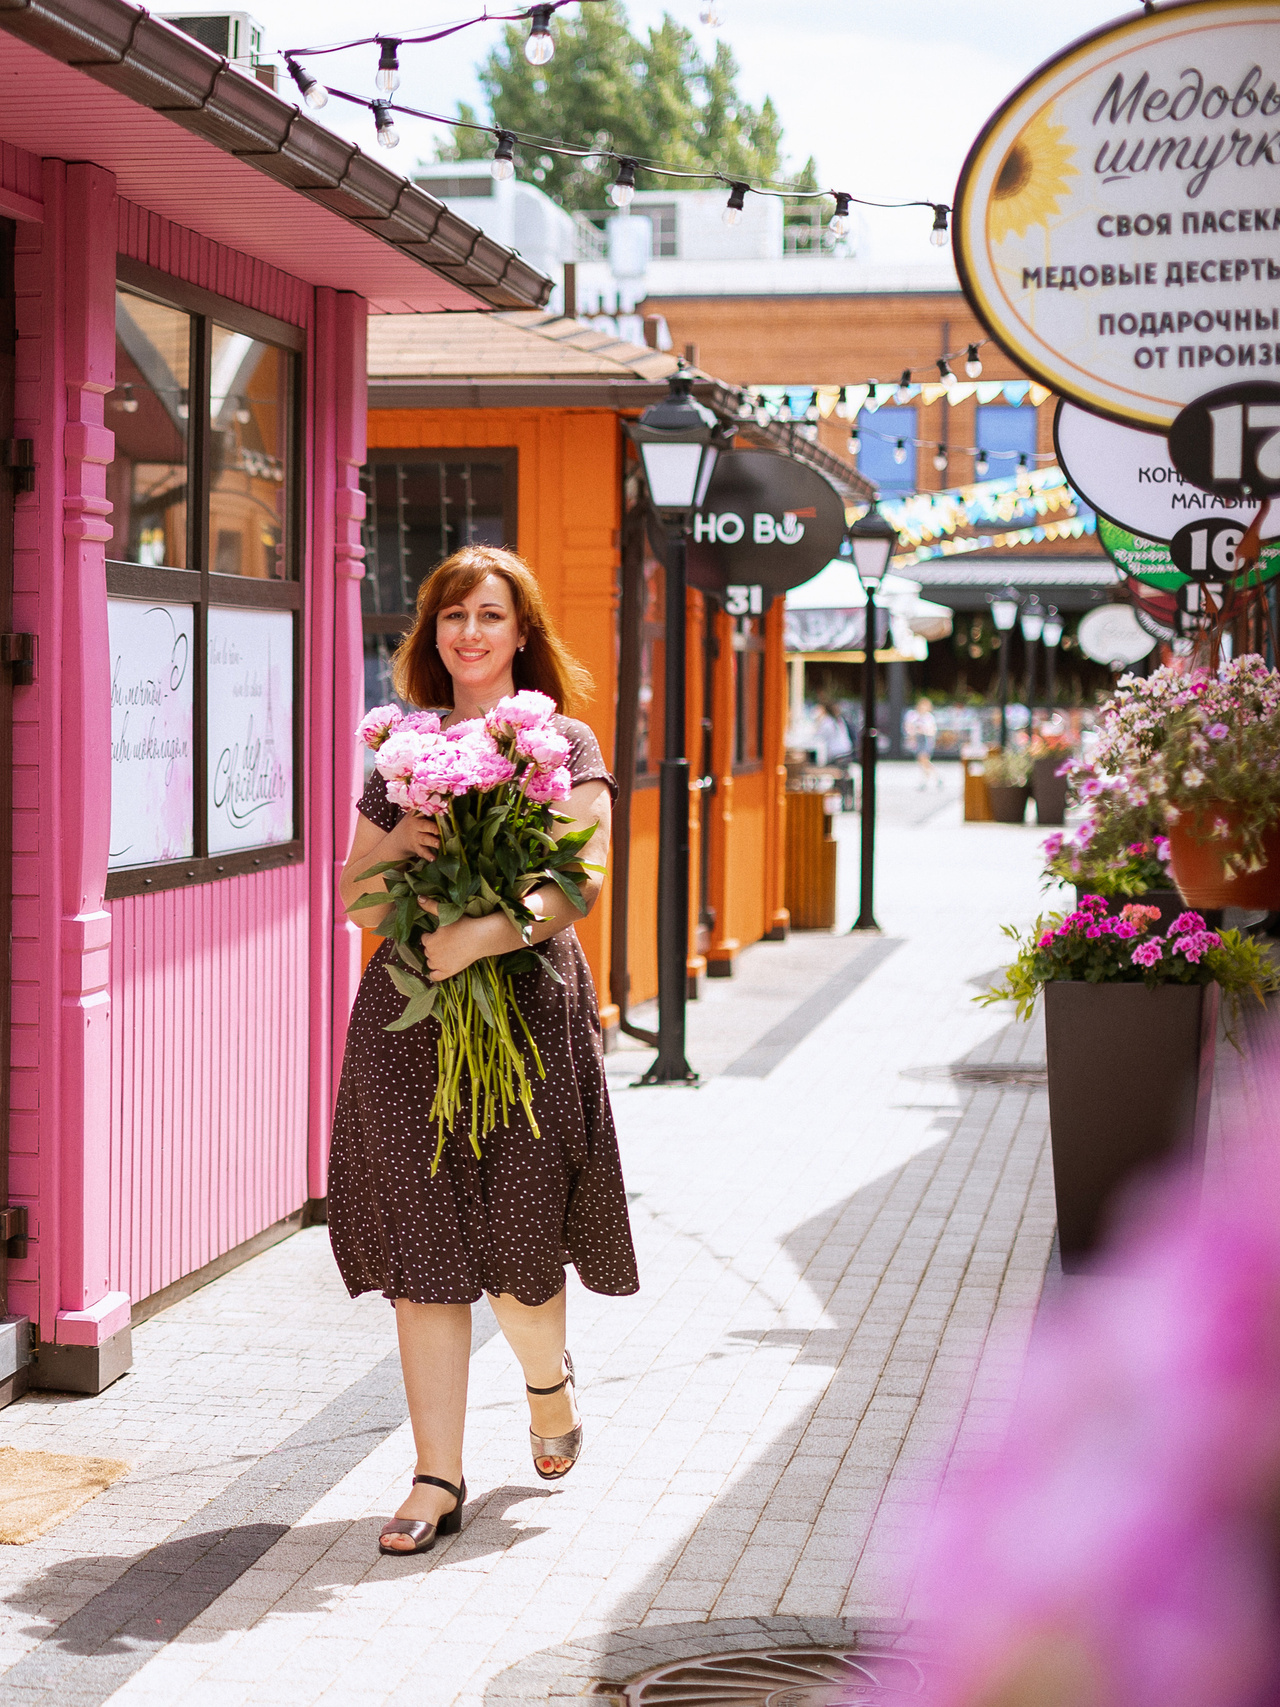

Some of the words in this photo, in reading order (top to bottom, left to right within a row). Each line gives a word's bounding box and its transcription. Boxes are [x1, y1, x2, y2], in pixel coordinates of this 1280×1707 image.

[1097, 213, 1172, 238] СВОЯ
[1022, 262, 1158, 291] МЕДОВЫЕ
[1134, 346, 1170, 370] ОТ
[1190, 528, 1246, 572] 16
[725, 584, 763, 615] 31
